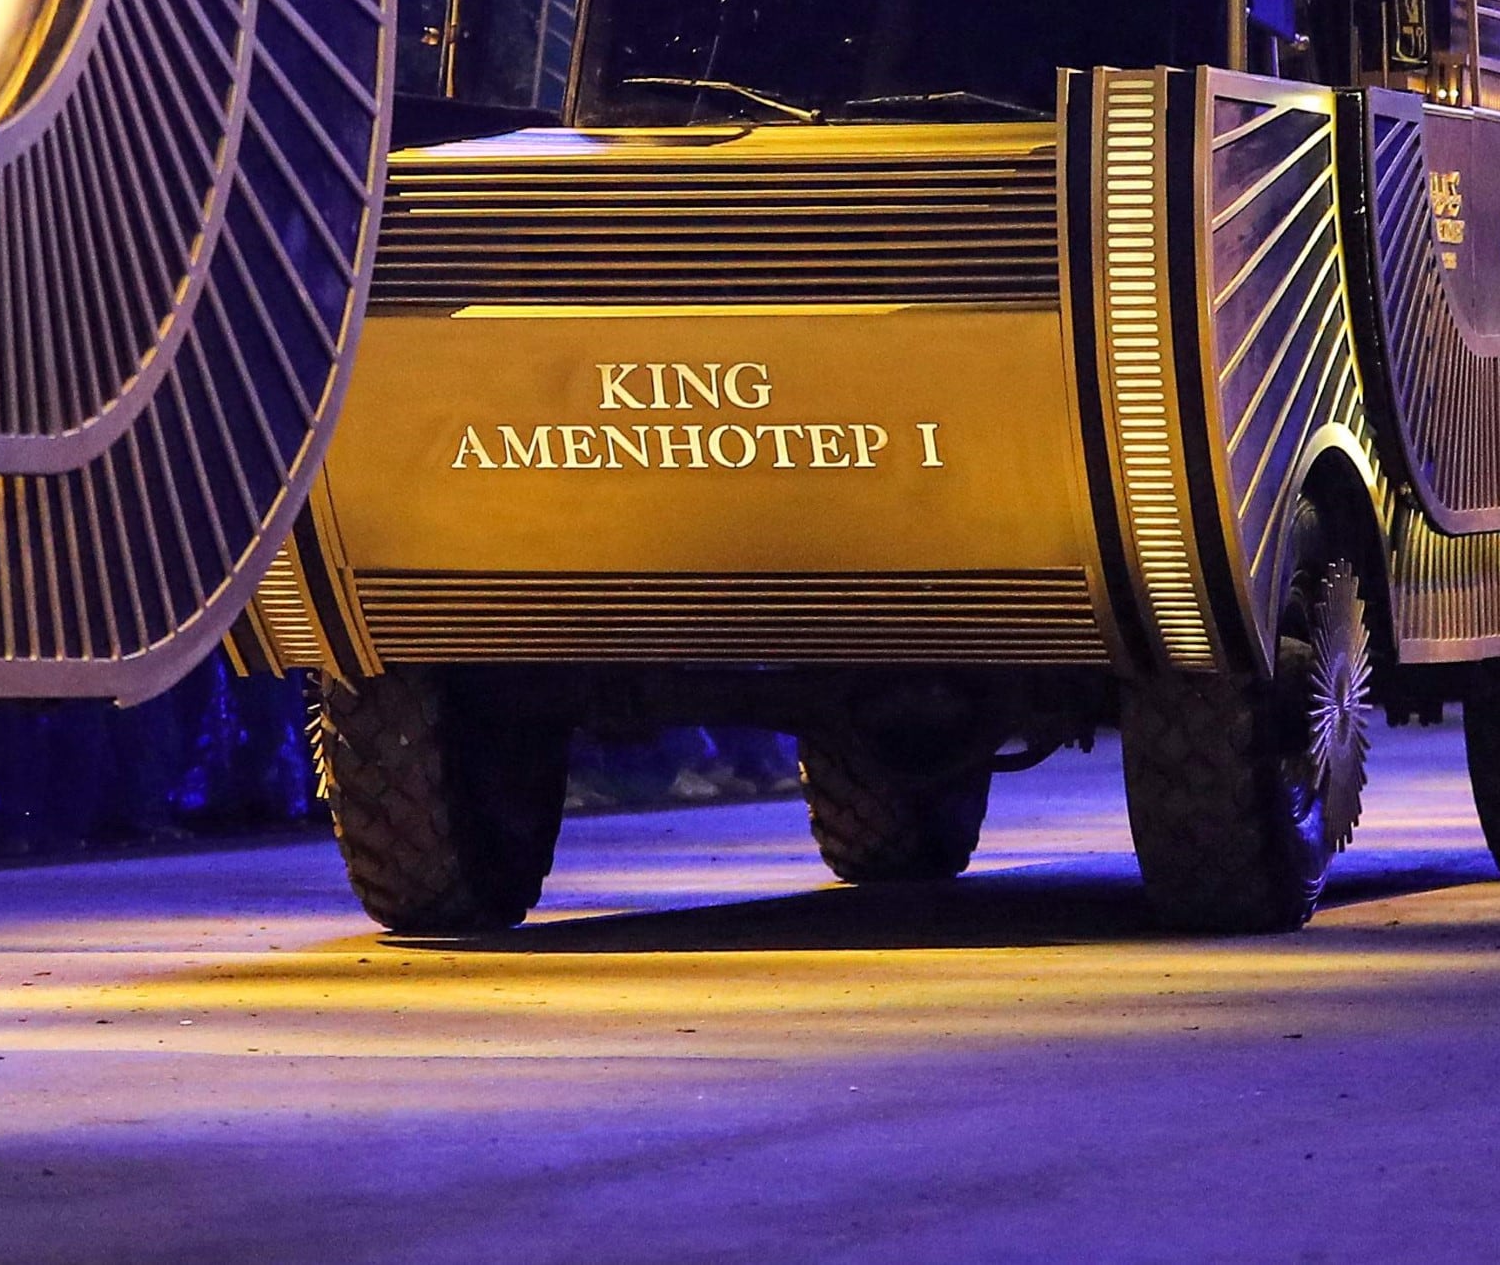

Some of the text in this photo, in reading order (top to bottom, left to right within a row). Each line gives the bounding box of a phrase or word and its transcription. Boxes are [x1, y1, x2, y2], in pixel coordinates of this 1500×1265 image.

[595, 362, 773, 410] KING
[451, 422, 945, 469] AMENHOTEP I
